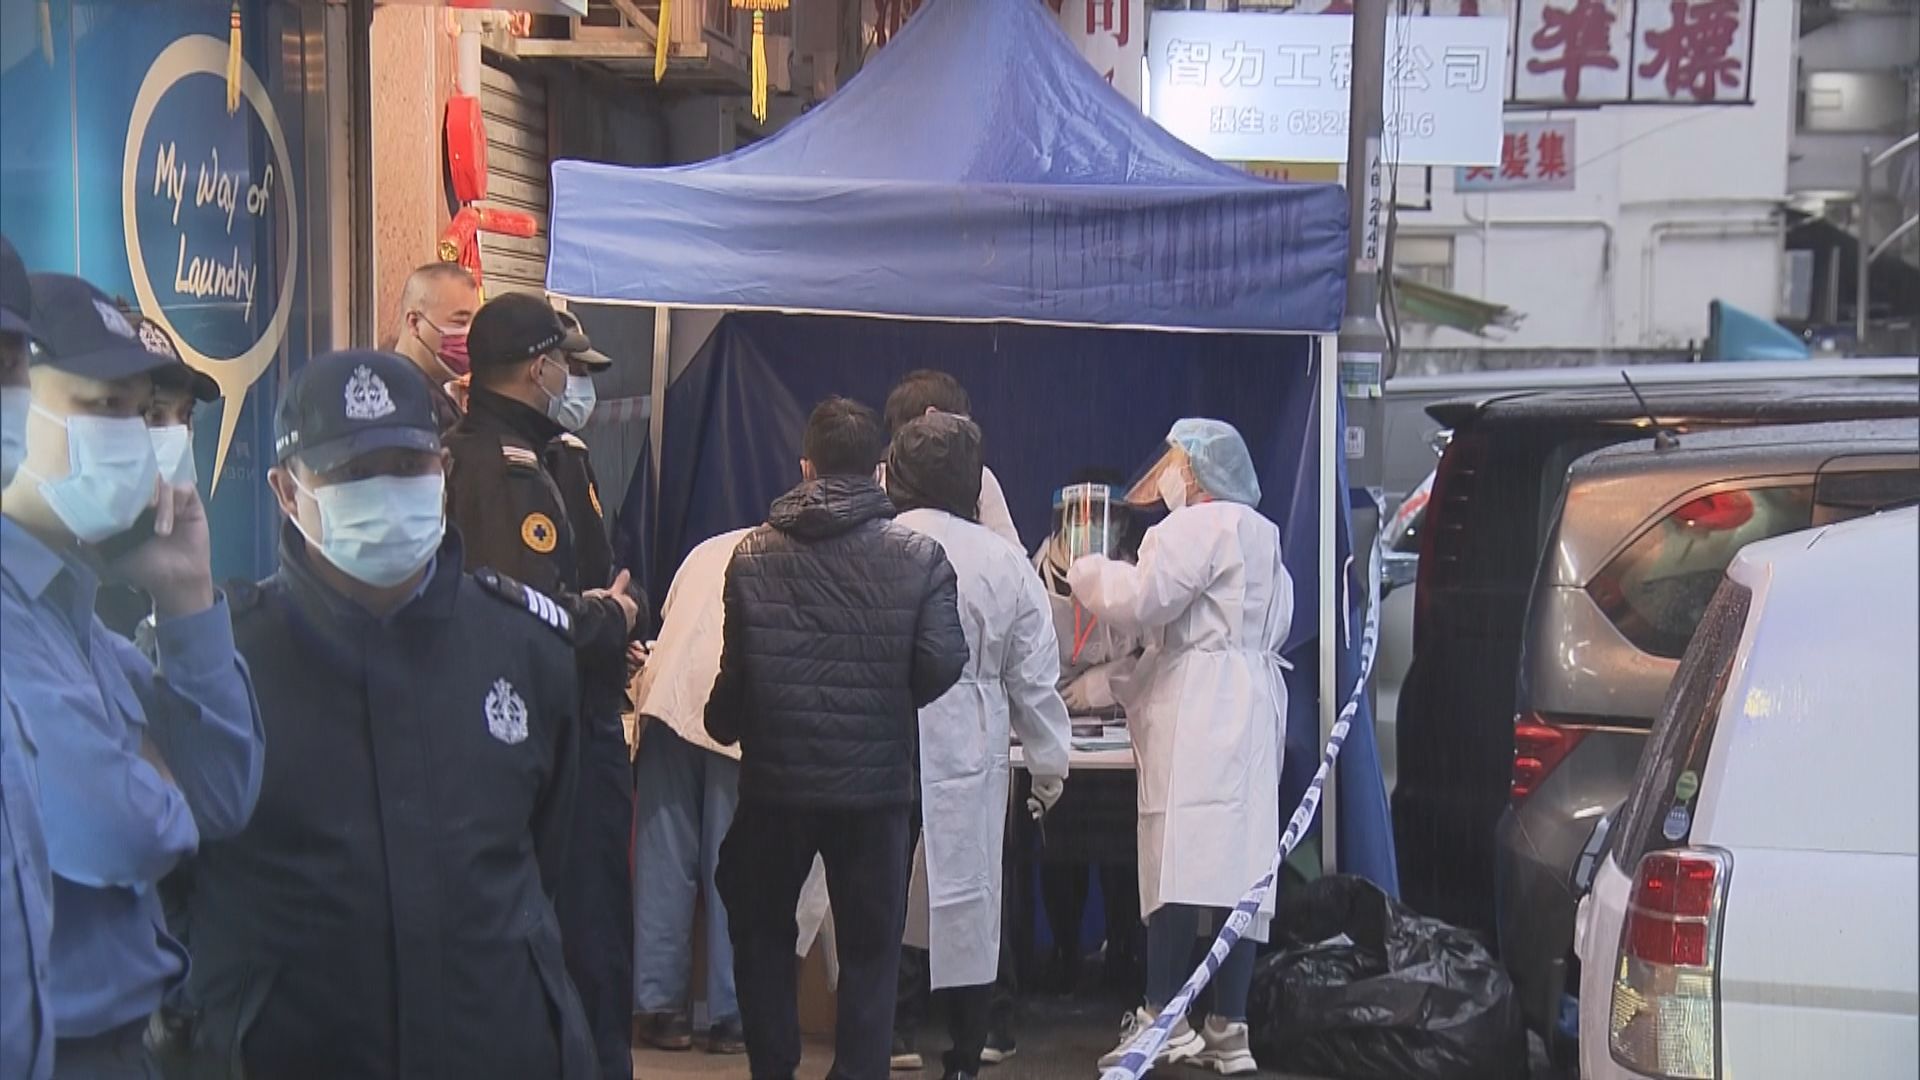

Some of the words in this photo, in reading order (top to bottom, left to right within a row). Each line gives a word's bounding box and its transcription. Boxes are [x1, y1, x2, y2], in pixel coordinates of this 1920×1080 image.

[153, 141, 187, 226] My
[195, 147, 240, 236] Way
[246, 164, 275, 217] of
[174, 232, 257, 324] Laundry
